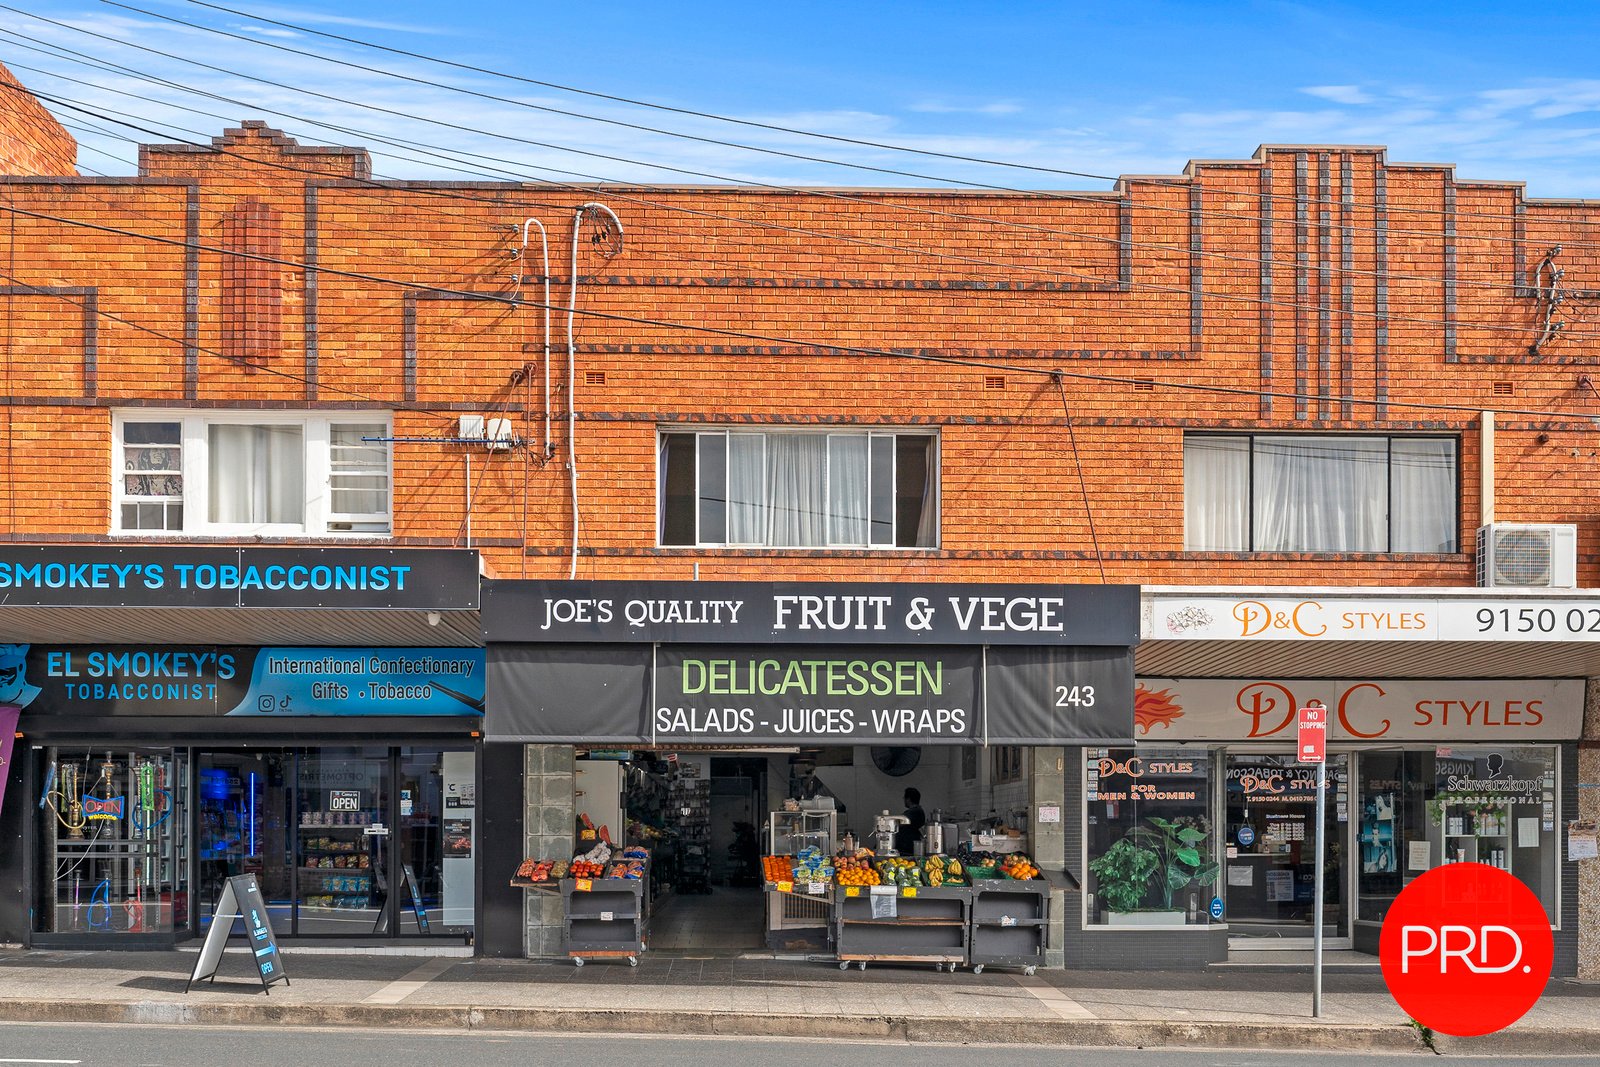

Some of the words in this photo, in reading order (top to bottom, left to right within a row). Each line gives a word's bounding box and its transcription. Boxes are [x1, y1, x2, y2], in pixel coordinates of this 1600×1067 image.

[0, 563, 164, 590] SMOKEY'S
[174, 564, 411, 591] TOBACCONIST
[541, 598, 613, 630] JOE'S
[624, 600, 744, 627] QUALITY
[773, 595, 892, 630] FRUIT
[905, 597, 936, 631] &
[949, 597, 1064, 632] VEGE
[1342, 612, 1426, 630] STYLES
[1475, 608, 1556, 633] 9150
[1566, 608, 1600, 632] 02
[46, 652, 79, 678] EL
[87, 652, 236, 680] SMOKEY'S
[268, 656, 366, 676] International
[368, 656, 475, 678] Confectionary
[682, 658, 943, 696] DELICATESSEN
[65, 683, 217, 700] TOBACCONIST
[311, 681, 349, 700] Gifts
[368, 681, 433, 700] Tobacco
[1055, 685, 1095, 707] 243
[656, 707, 754, 733] SALADS
[774, 708, 854, 734] JUICES
[872, 709, 966, 734] WRAPS
[1307, 711, 1318, 720] NO
[1414, 700, 1544, 726] STYLES
[1299, 721, 1326, 729] STOPPING
[1149, 762, 1193, 774] STYLES
[1131, 784, 1156, 792] FOR
[1290, 779, 1331, 789] STYLS
[1447, 775, 1544, 796] Schwarzkopf
[333, 798, 357, 809] OPEN
[1097, 792, 1126, 800] MEN
[1131, 792, 1140, 800] &
[1144, 791, 1195, 800] WOMEN
[1449, 796, 1542, 804] PROFESSIONAL
[85, 800, 120, 814] OPEN
